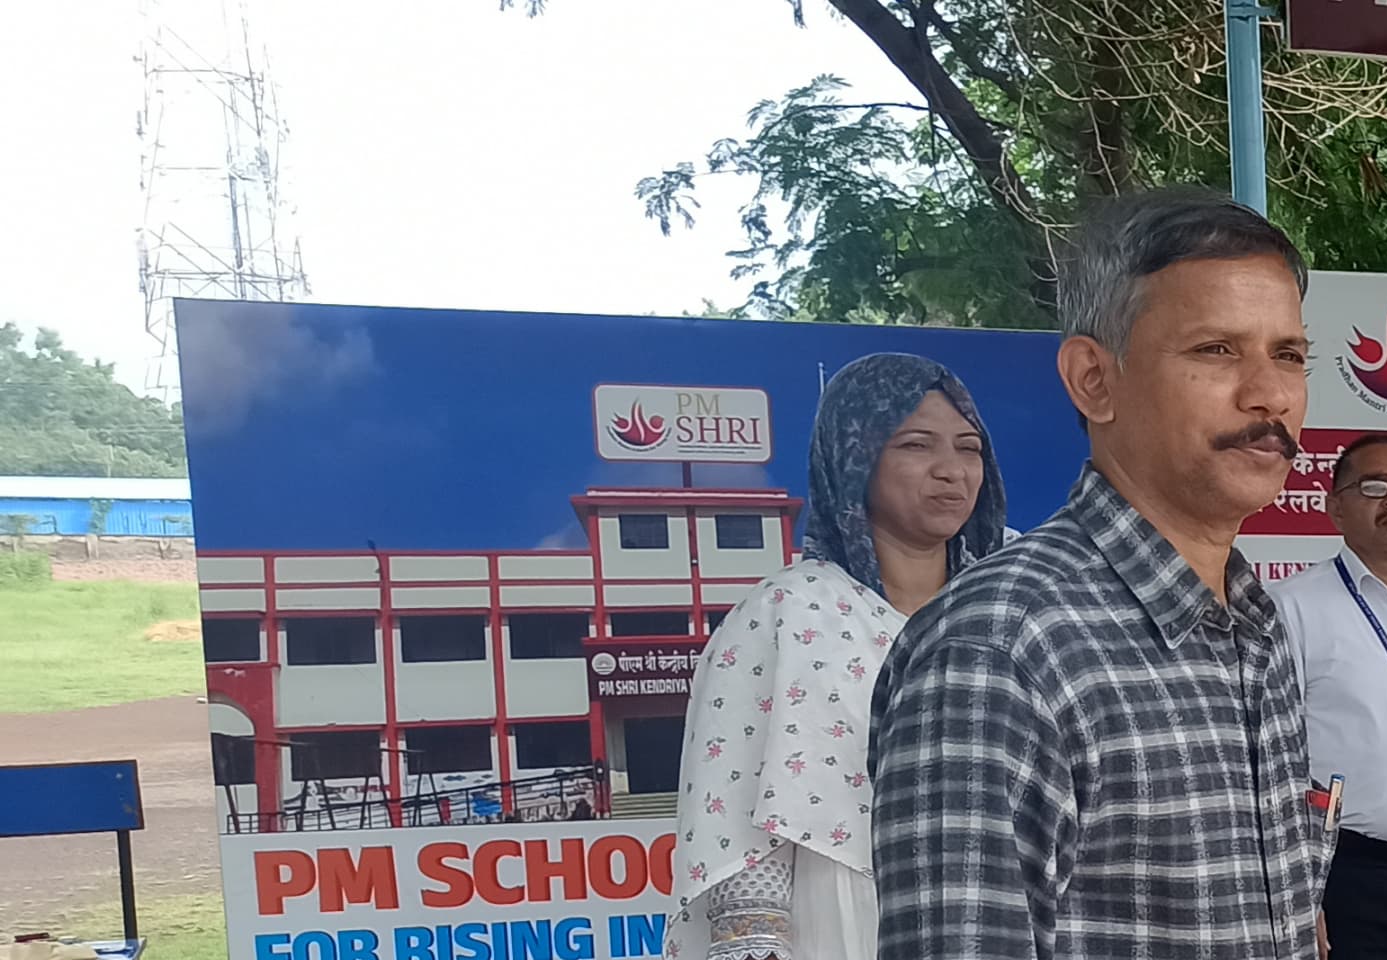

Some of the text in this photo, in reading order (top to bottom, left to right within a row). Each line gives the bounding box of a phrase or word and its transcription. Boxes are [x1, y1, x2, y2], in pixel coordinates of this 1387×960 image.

[676, 393, 720, 416] PM
[1358, 390, 1386, 413] Mantri
[675, 416, 762, 444] SHRI
[598, 681, 614, 695] PM
[615, 680, 638, 695] SHRI
[254, 845, 400, 915] PM
